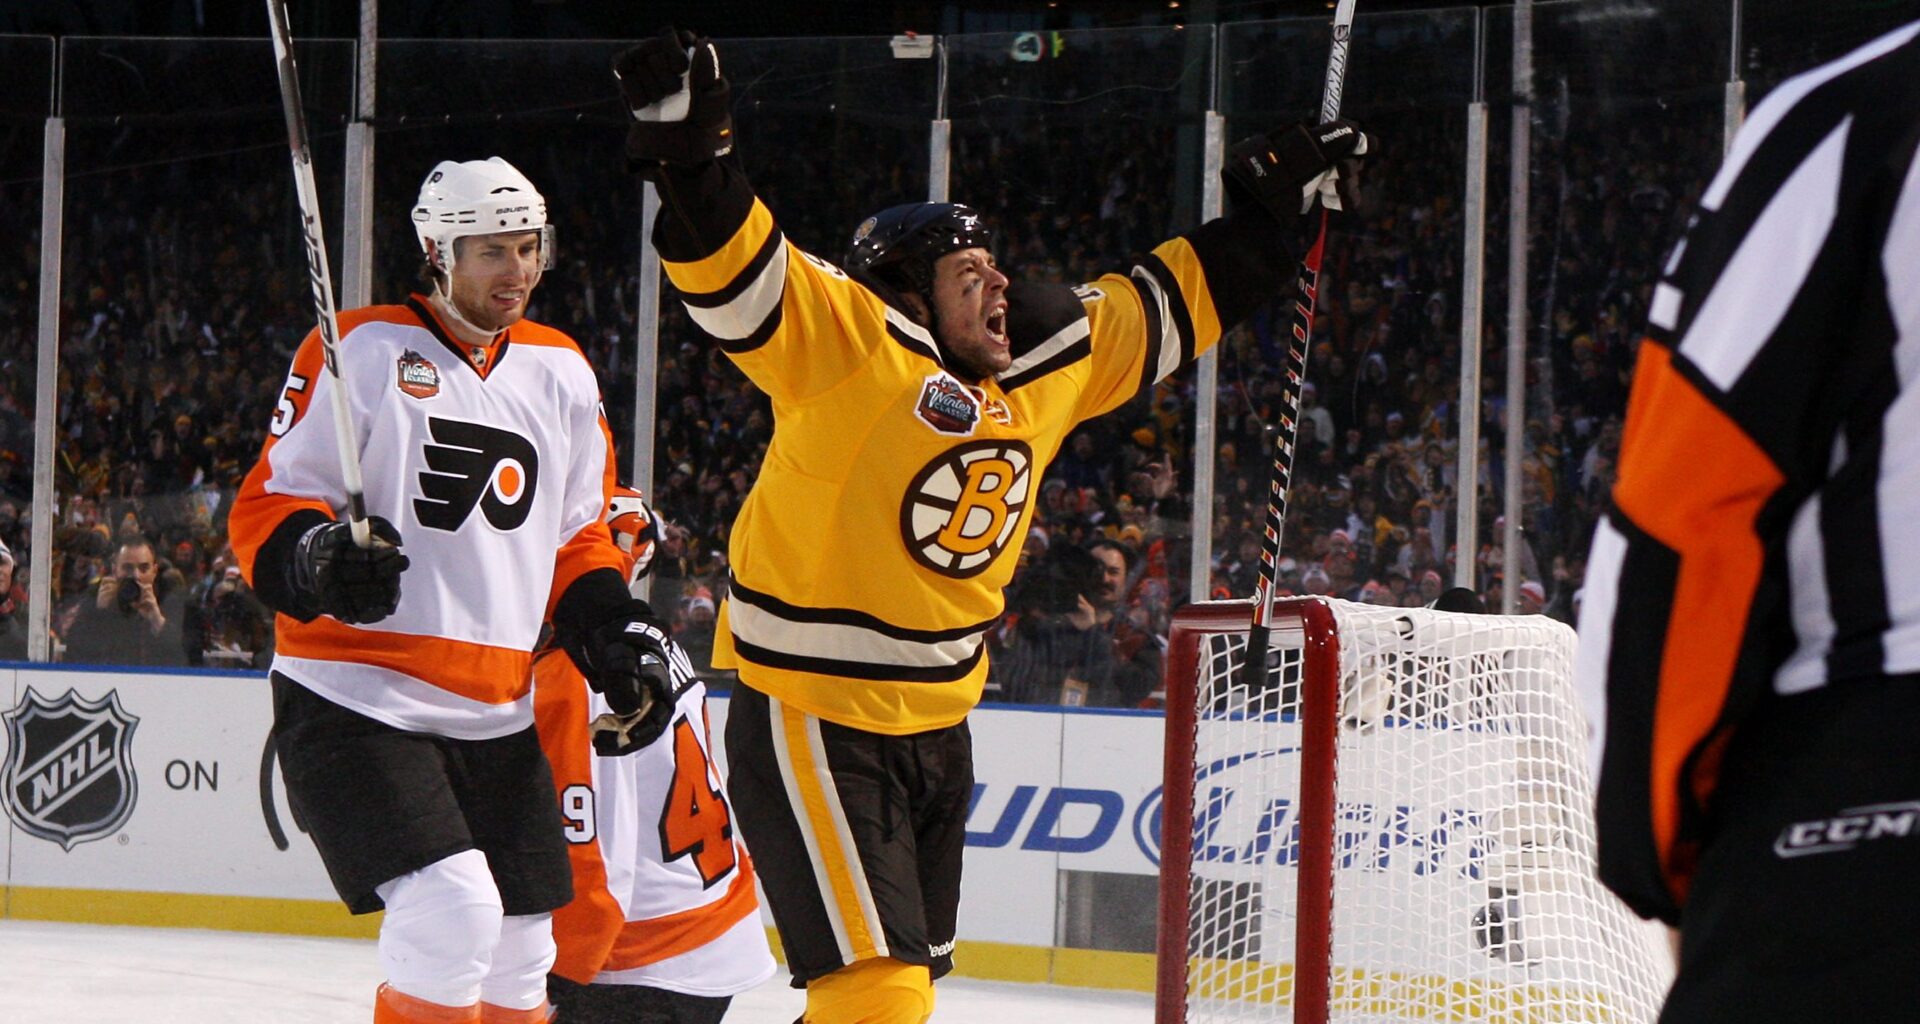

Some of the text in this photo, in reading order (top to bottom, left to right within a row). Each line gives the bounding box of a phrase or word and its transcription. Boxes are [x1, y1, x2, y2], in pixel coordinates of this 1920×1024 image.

[928, 385, 972, 414] Winter
[31, 733, 218, 811] NHL ON
[658, 711, 736, 891] 4
[561, 783, 597, 844] 9
[963, 783, 1126, 853] UD
[1788, 812, 1915, 847] CCM
